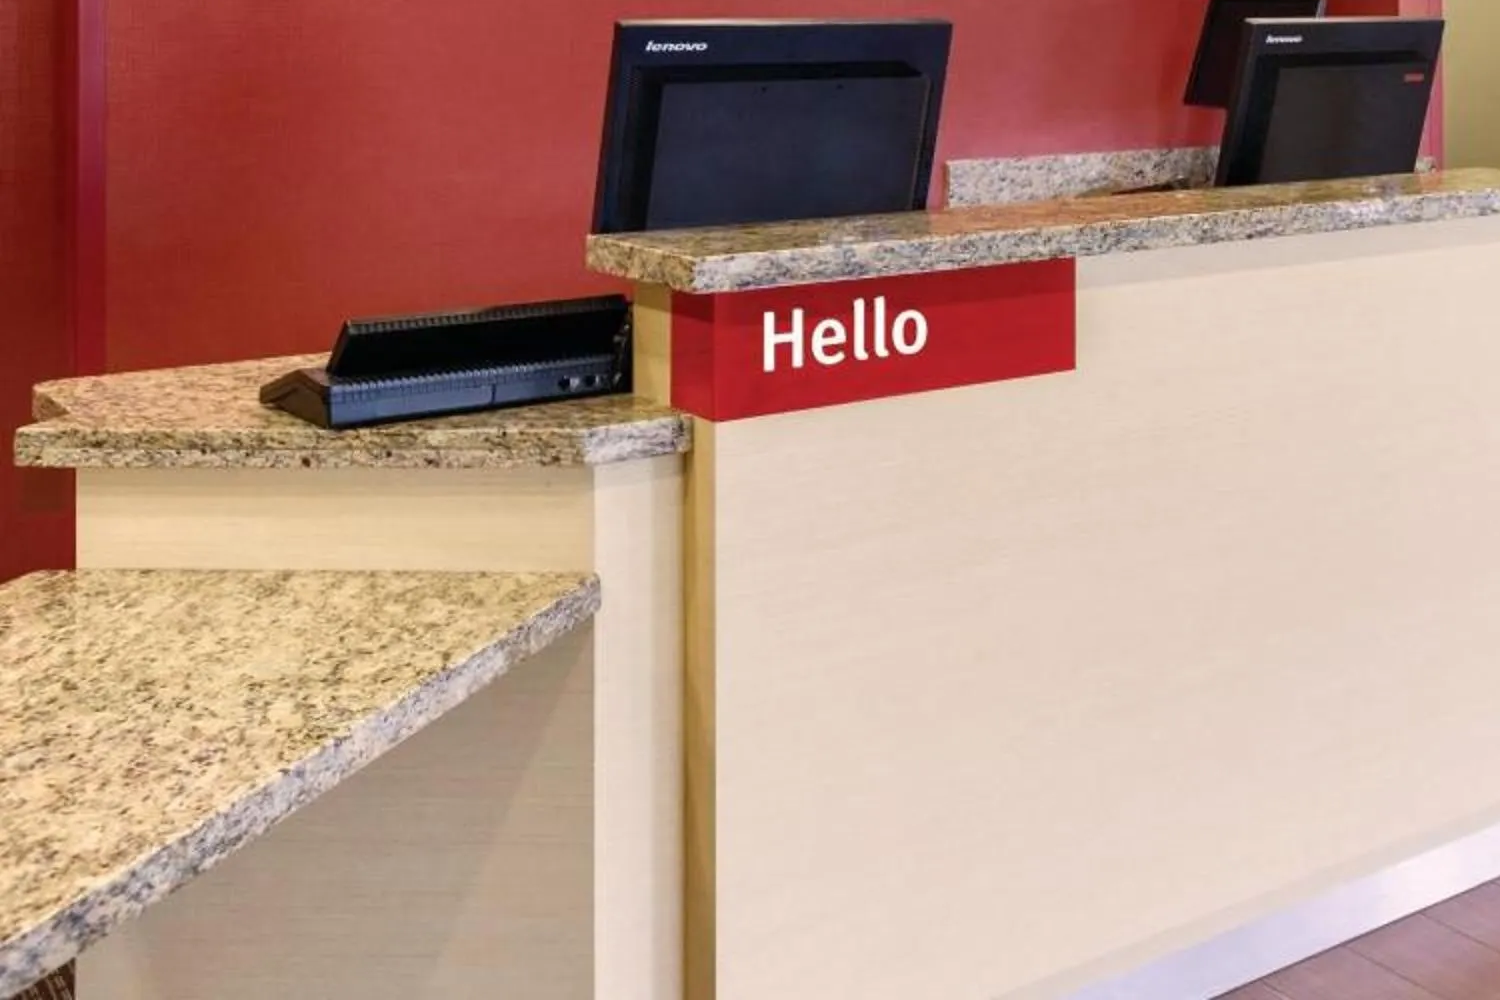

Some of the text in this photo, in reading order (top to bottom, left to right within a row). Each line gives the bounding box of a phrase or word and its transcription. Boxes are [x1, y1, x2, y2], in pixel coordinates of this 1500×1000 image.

[645, 39, 708, 52] lenovo
[1265, 34, 1303, 44] lenovo
[762, 295, 929, 373] Hello
